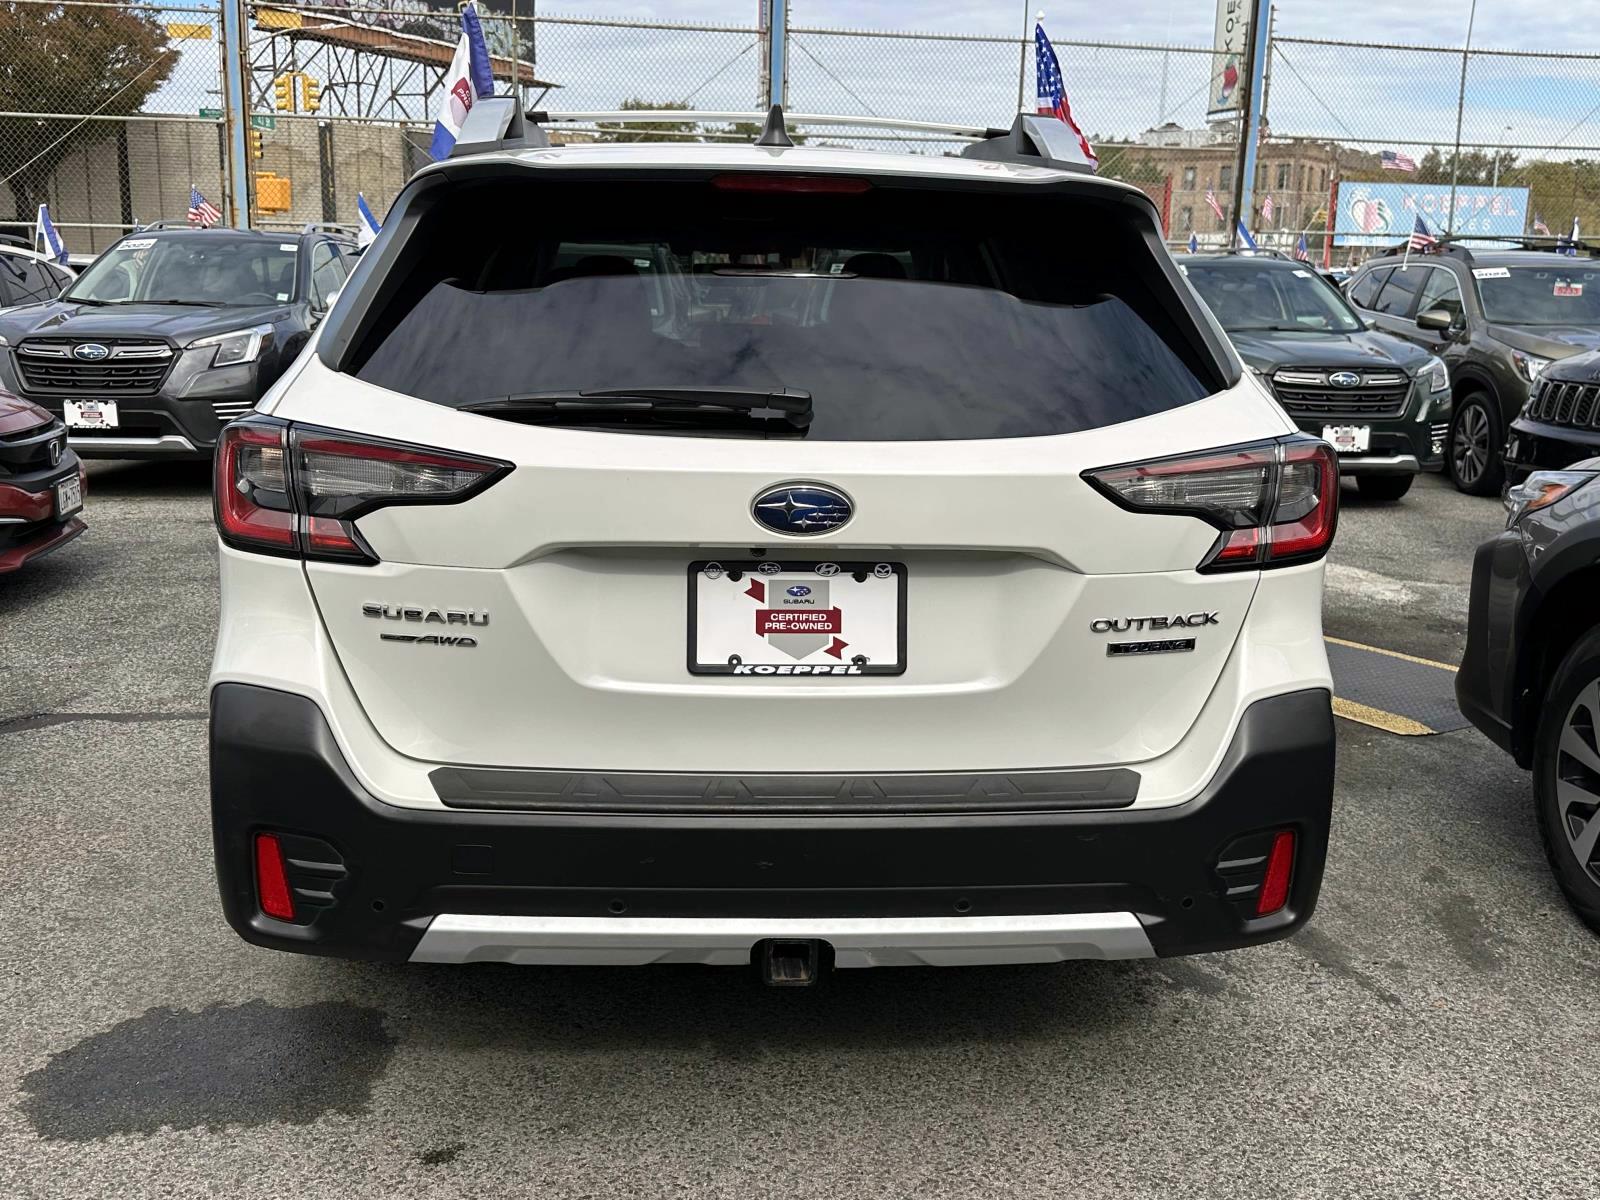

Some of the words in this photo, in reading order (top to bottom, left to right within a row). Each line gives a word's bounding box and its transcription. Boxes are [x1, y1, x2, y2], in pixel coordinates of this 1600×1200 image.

[1403, 193, 1518, 216] KOEPPEL
[363, 602, 490, 626] SUBARU
[770, 613, 827, 621] CERTIFIED
[765, 622, 833, 630] PRE-OWNED
[1090, 610, 1220, 633] OUTBACK
[1119, 640, 1187, 654] TOURING
[733, 665, 862, 675] KOEPPEL
